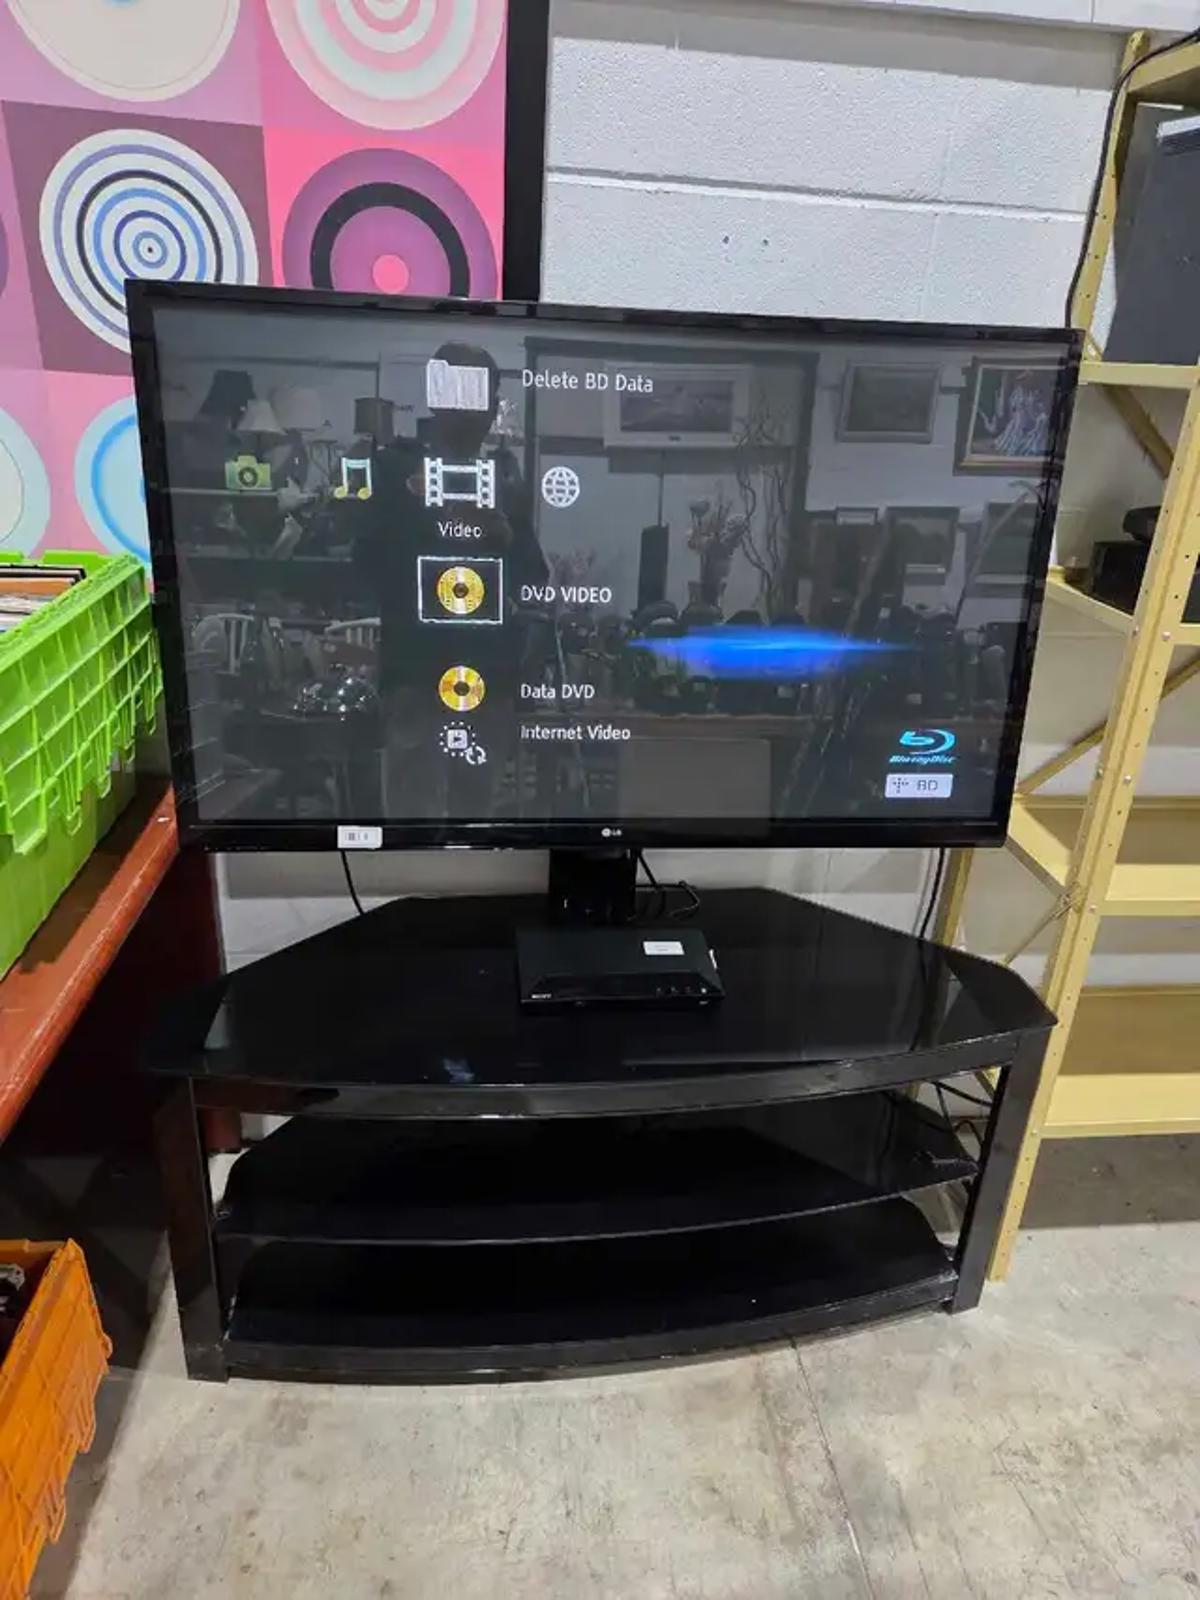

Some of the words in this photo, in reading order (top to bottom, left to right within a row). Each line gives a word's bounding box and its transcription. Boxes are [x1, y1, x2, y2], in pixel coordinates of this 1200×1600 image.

[522, 369, 578, 389] Delete
[585, 372, 609, 390] BD
[615, 374, 654, 393] Data
[438, 521, 482, 538] Video
[521, 584, 556, 603] DVD
[561, 586, 612, 604] VIDEO
[520, 684, 556, 699] Data
[561, 684, 595, 699] DVD
[520, 725, 582, 741] Internet
[587, 725, 631, 741] Video
